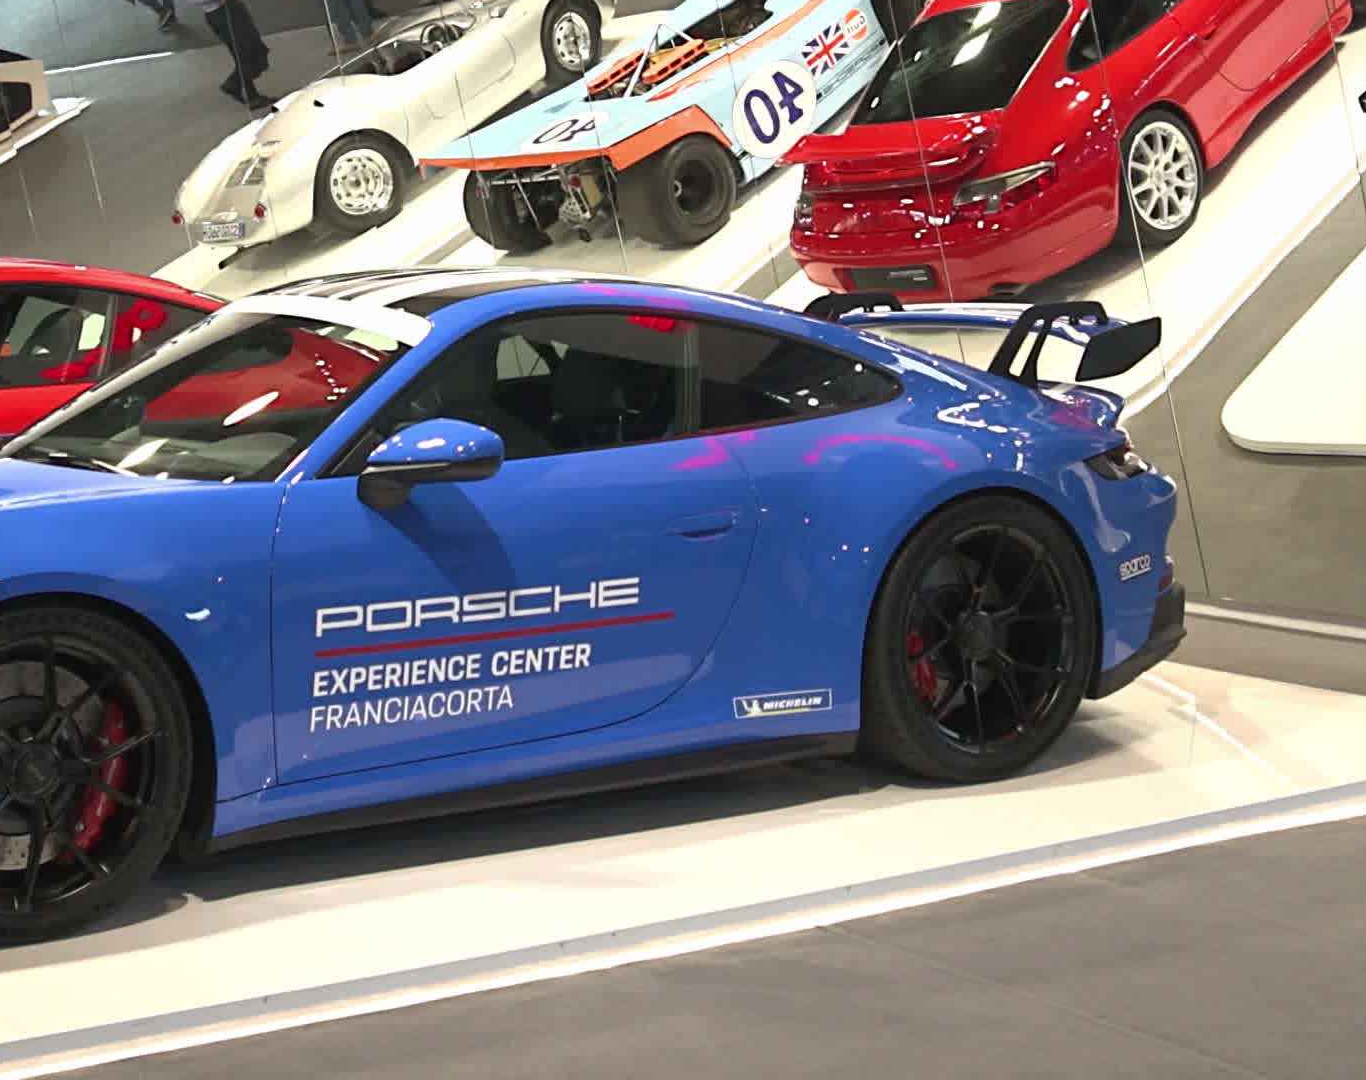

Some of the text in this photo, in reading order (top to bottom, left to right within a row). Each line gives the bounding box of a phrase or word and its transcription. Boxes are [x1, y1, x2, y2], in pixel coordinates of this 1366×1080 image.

[315, 577, 640, 637] PORSCHE
[312, 643, 592, 697] EXPERIENCE CENTER
[310, 684, 514, 733] FRANCIACORTA
[763, 696, 823, 710] MICHELIN
